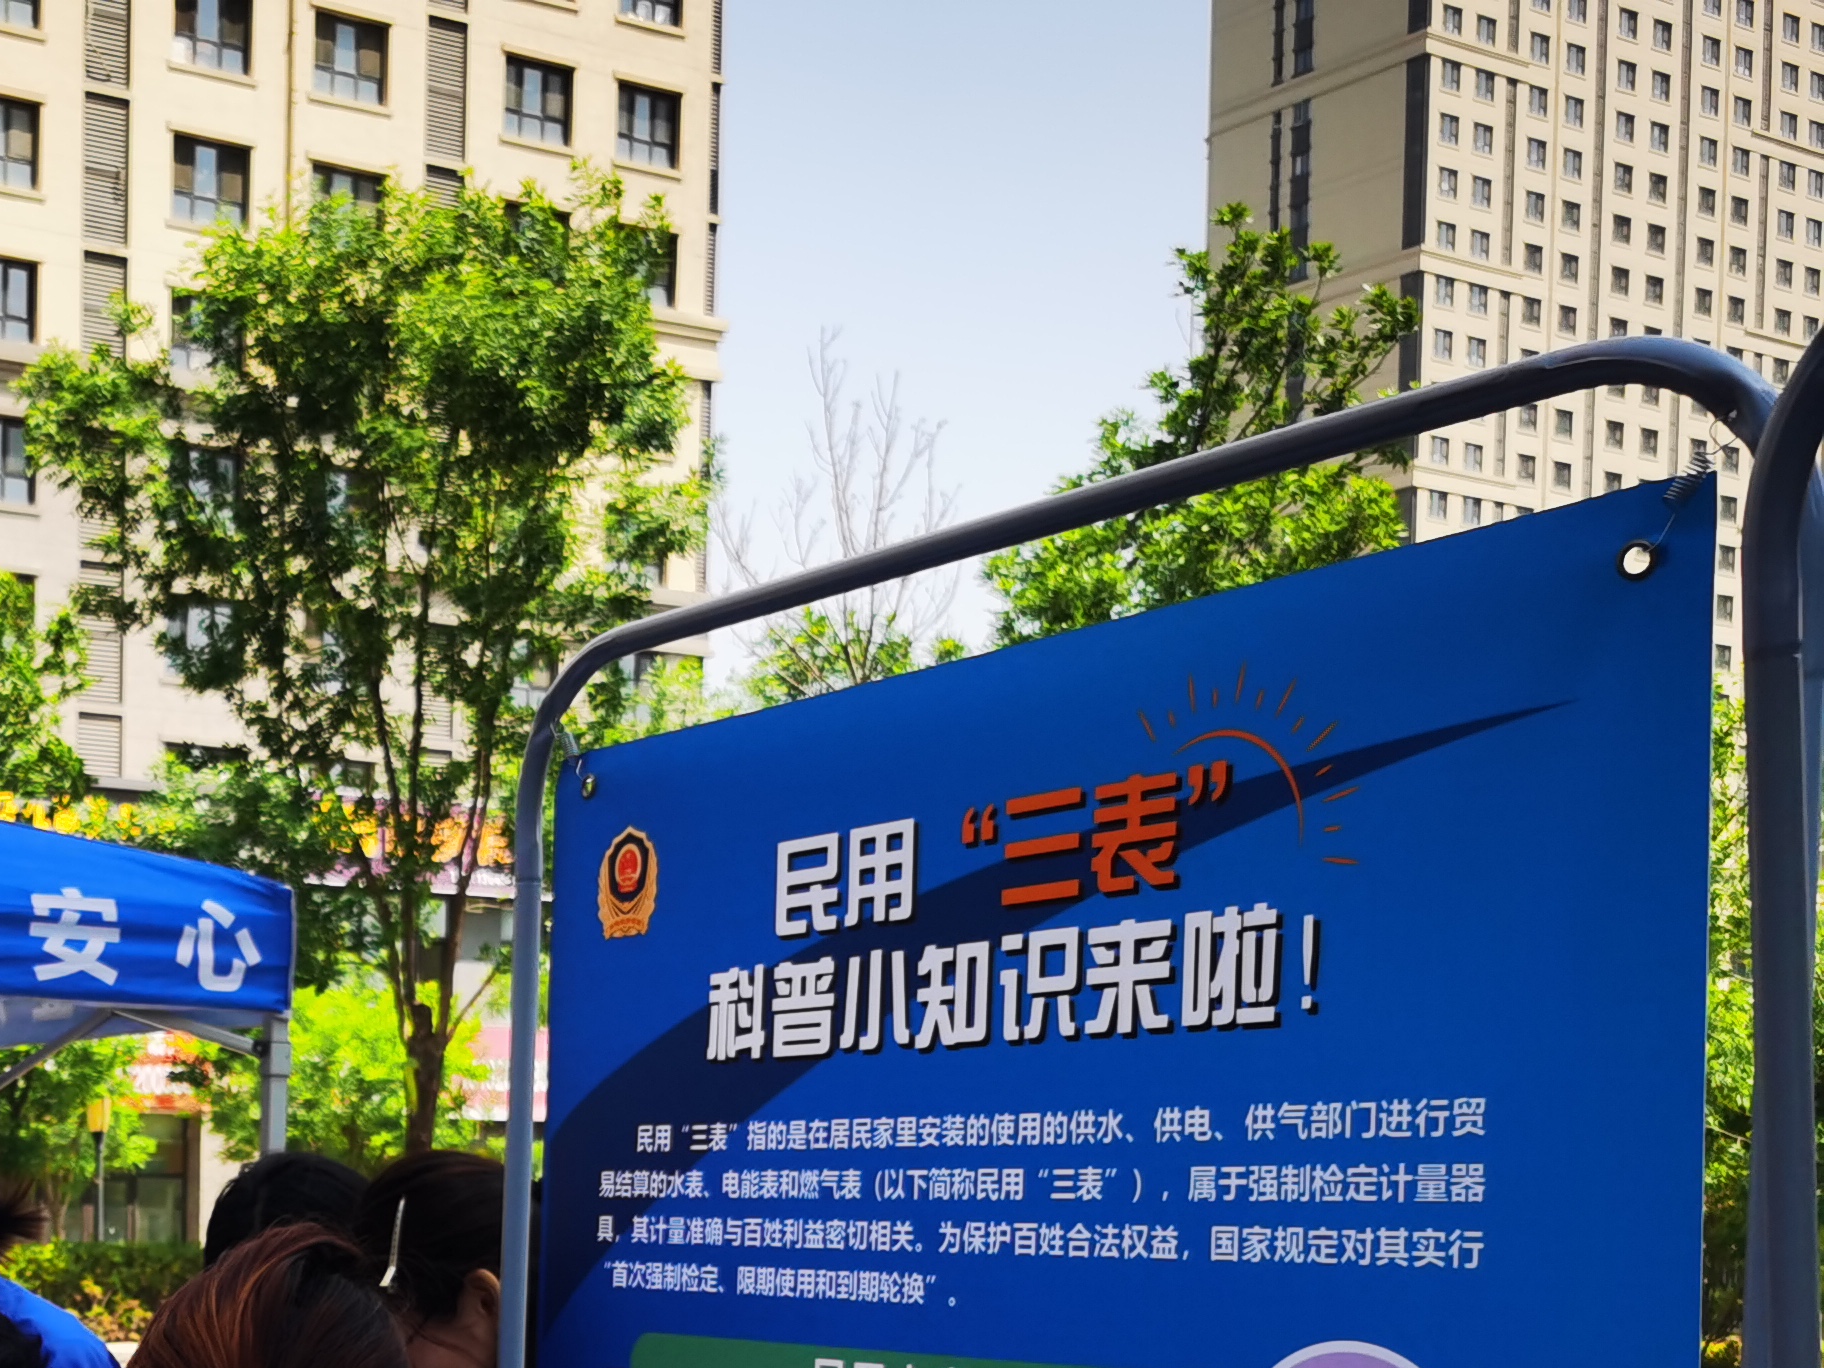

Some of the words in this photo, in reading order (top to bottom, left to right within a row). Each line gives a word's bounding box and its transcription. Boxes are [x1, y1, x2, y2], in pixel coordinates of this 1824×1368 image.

[775, 761, 1231, 938] 民用“三表”
[706, 901, 1322, 1062] 科普小知识来啦！
[636, 1097, 1487, 1153] 民用“三表”指的是在居民家里安装的使用的供水、供电、供气部门进行贸
[596, 1214, 1485, 1269] 具，其计量准确与百姓利益密切相关。为保护百姓合法权益，国家规定对其实行
[604, 1260, 957, 1307] “首次强制检定、限期使用和到期轮换”。
